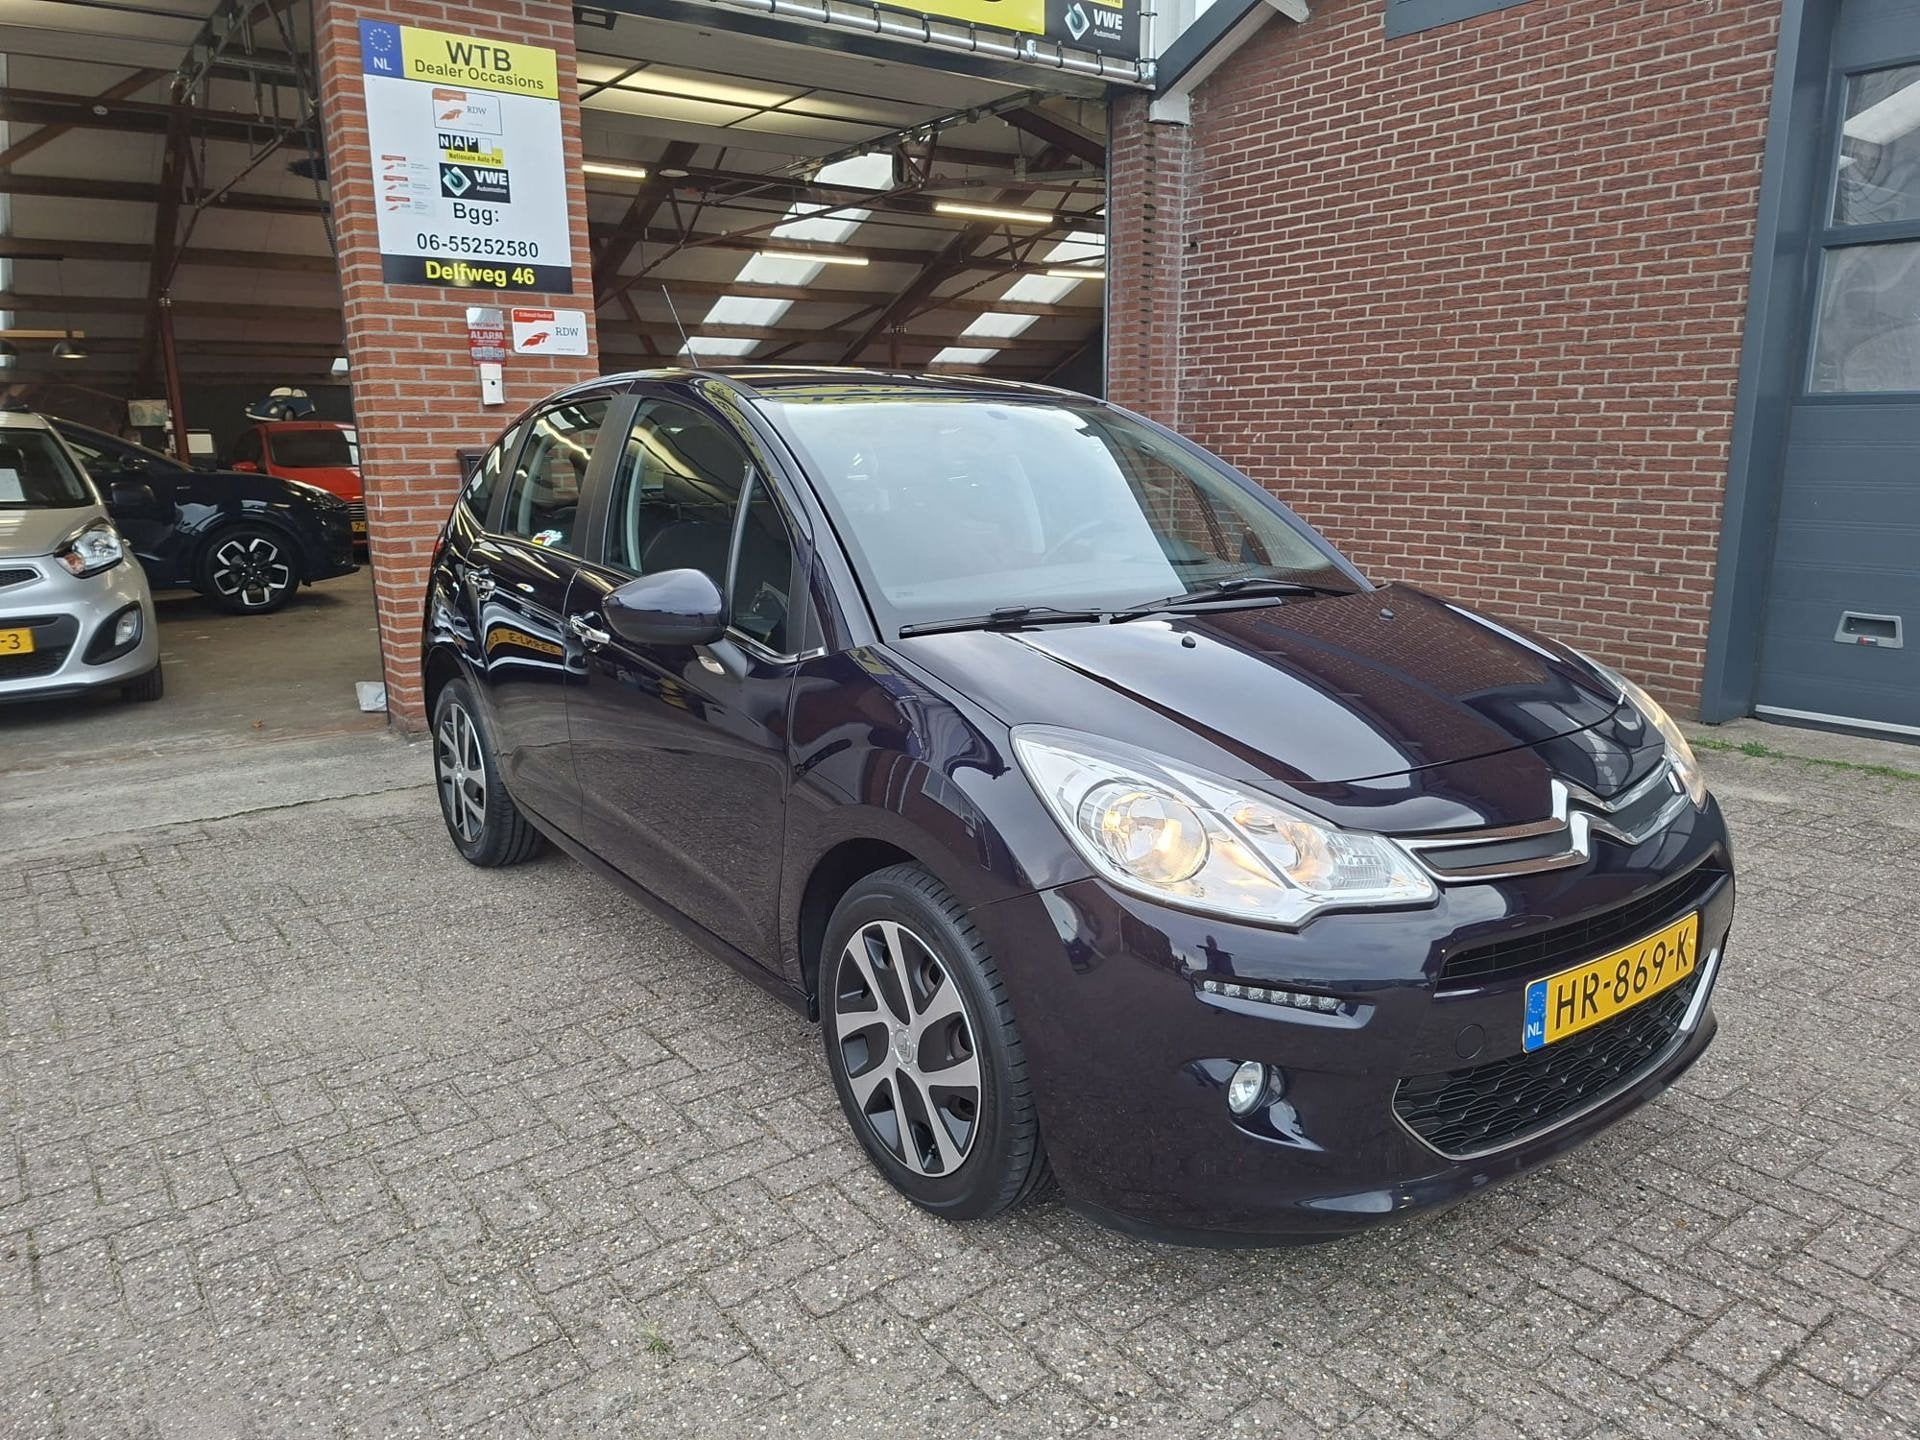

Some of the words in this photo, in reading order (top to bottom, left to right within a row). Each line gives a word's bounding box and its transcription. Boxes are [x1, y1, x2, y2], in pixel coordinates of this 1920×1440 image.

[1093, 9, 1123, 31] VWE
[373, 57, 392, 71] NL
[446, 40, 512, 72] WTB
[415, 59, 463, 79] Dealer
[468, 67, 544, 90] Occasions
[466, 105, 487, 115] RDW
[440, 136, 477, 149] NAP
[473, 169, 508, 186] VWE
[453, 202, 499, 226] Bgg:
[417, 233, 539, 258] 06-55252580
[425, 260, 507, 287] Delfweg
[511, 267, 535, 285] 46
[470, 331, 504, 340] ALARM
[555, 327, 579, 337] RDW
[1555, 926, 1691, 1030] HR-869-K
[1527, 1021, 1543, 1038] NL
